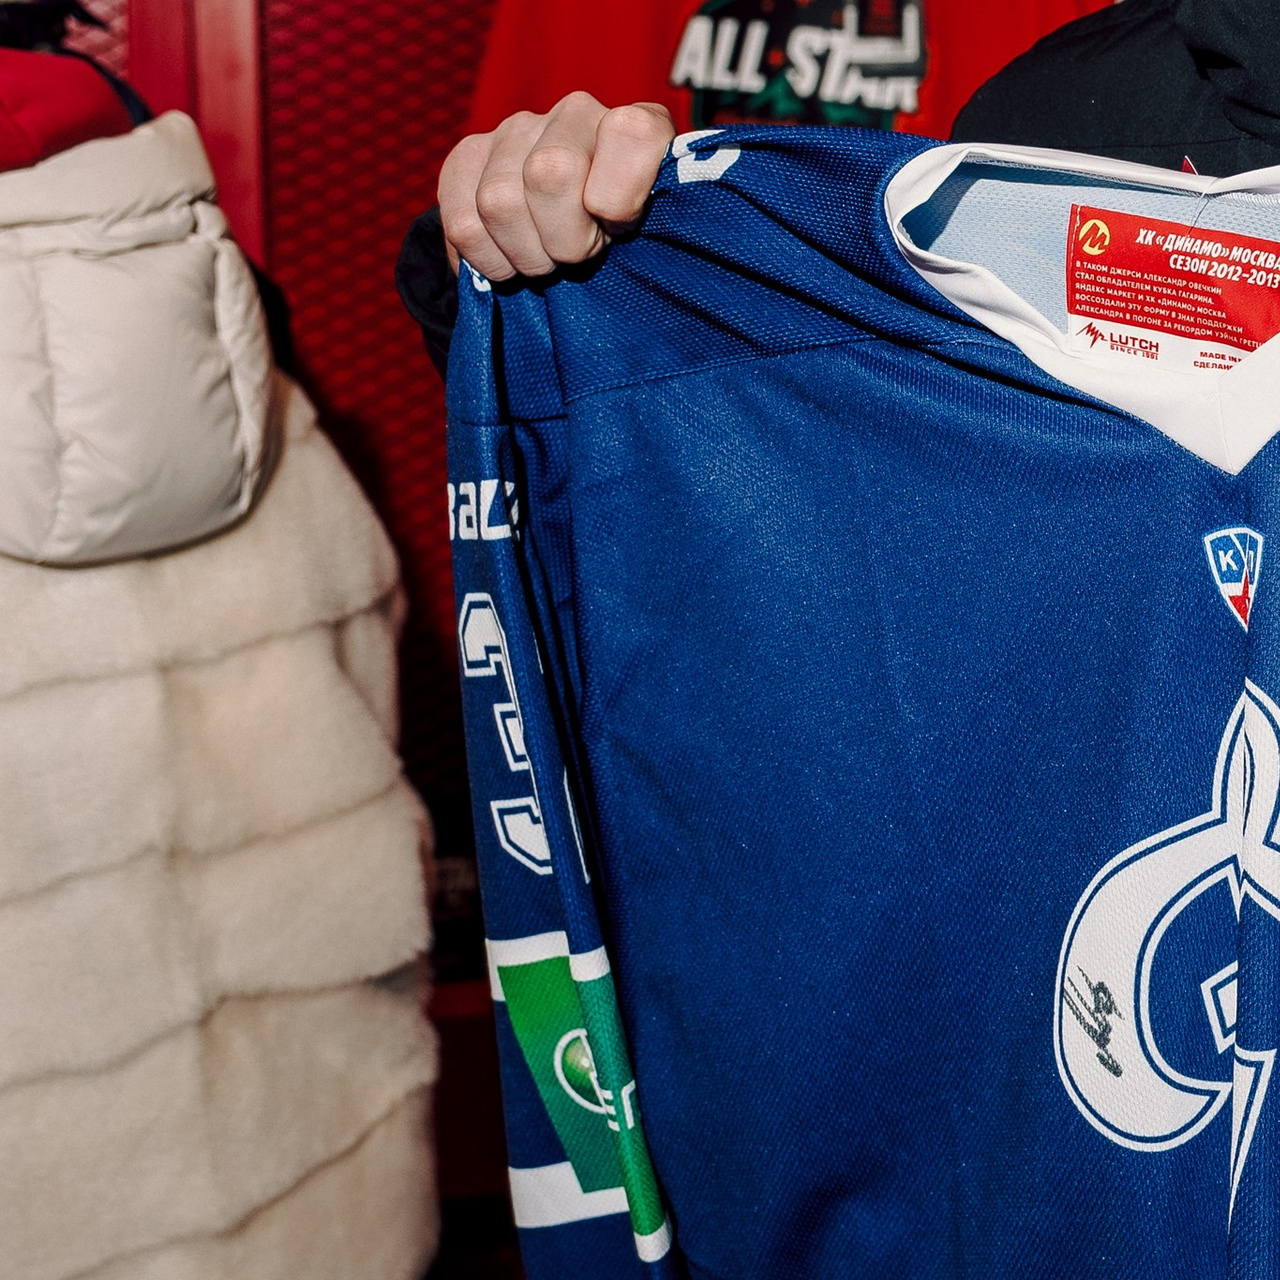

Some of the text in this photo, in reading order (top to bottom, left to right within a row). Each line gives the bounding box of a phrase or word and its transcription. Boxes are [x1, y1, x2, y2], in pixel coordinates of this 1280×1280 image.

[668, 15, 769, 94] ALL
[1135, 228, 1156, 246] ХК
[1156, 233, 1229, 258] «ДИНАМО»
[1075, 271, 1214, 305] СТАЛ ОБЛАДАТЕЛЕМ КУБКА ГАГАРИНА.
[1083, 261, 1108, 272] ТАКОМ
[1110, 267, 1141, 278] ДЖЕРСИ
[1143, 273, 1187, 286] АЛЕКСАНДР
[1188, 281, 1222, 295] ОВЕЧКИН
[1169, 254, 1280, 289] СЕЗОН 2012-2013
[1075, 282, 1105, 294] ЯНДЕКС
[1107, 288, 1136, 299] МАРКЕТ
[1145, 295, 1155, 303] ХК
[1197, 306, 1226, 318] МОСКВА
[1075, 293, 1126, 308] ВОССОЗДАЛИ
[1128, 303, 1141, 311] ЭТУ
[1143, 306, 1170, 318] ФОРМУ
[1177, 313, 1195, 323] ЗНАК
[1197, 317, 1243, 333] ПОДДЕРЖКИ
[1075, 304, 1124, 318] АЛЕКСАНДРА
[1132, 314, 1161, 326] ПОГОНЕ
[1163, 320, 1172, 328] ЗА
[1173, 322, 1213, 336] РЕКОРДОМ
[1215, 331, 1238, 342] УЭЙНА
[1240, 338, 1262, 349] ГРЕТЦ
[1110, 332, 1159, 352] LUTCH
[1110, 344, 1137, 356] SINCE
[1200, 351, 1227, 361] MADE
[1228, 355, 1237, 363] IN
